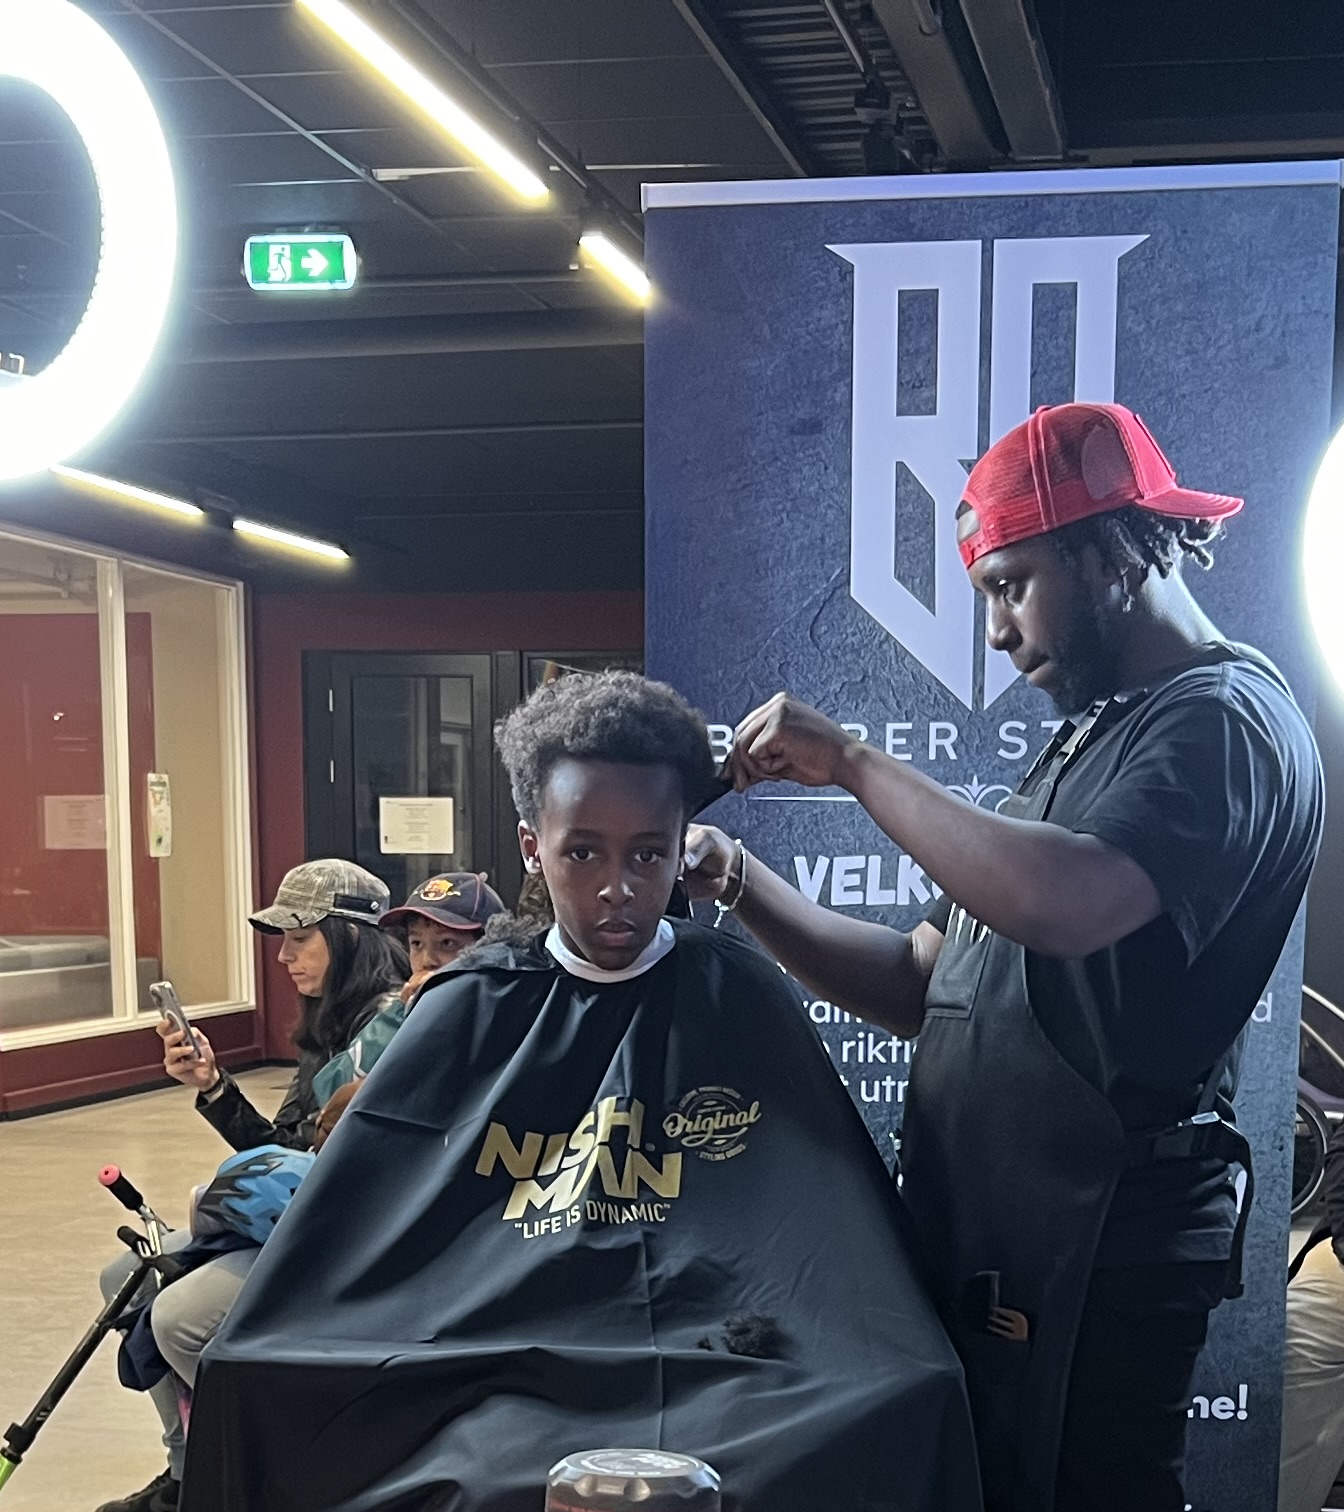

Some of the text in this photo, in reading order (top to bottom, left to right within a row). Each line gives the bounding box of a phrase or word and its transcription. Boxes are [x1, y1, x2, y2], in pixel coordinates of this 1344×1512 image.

[794, 854, 945, 907] VELK
[474, 1096, 646, 1179] NISH
[662, 1100, 762, 1147] Original
[502, 1146, 683, 1221] MAN
[566, 1204, 582, 1229] IS
